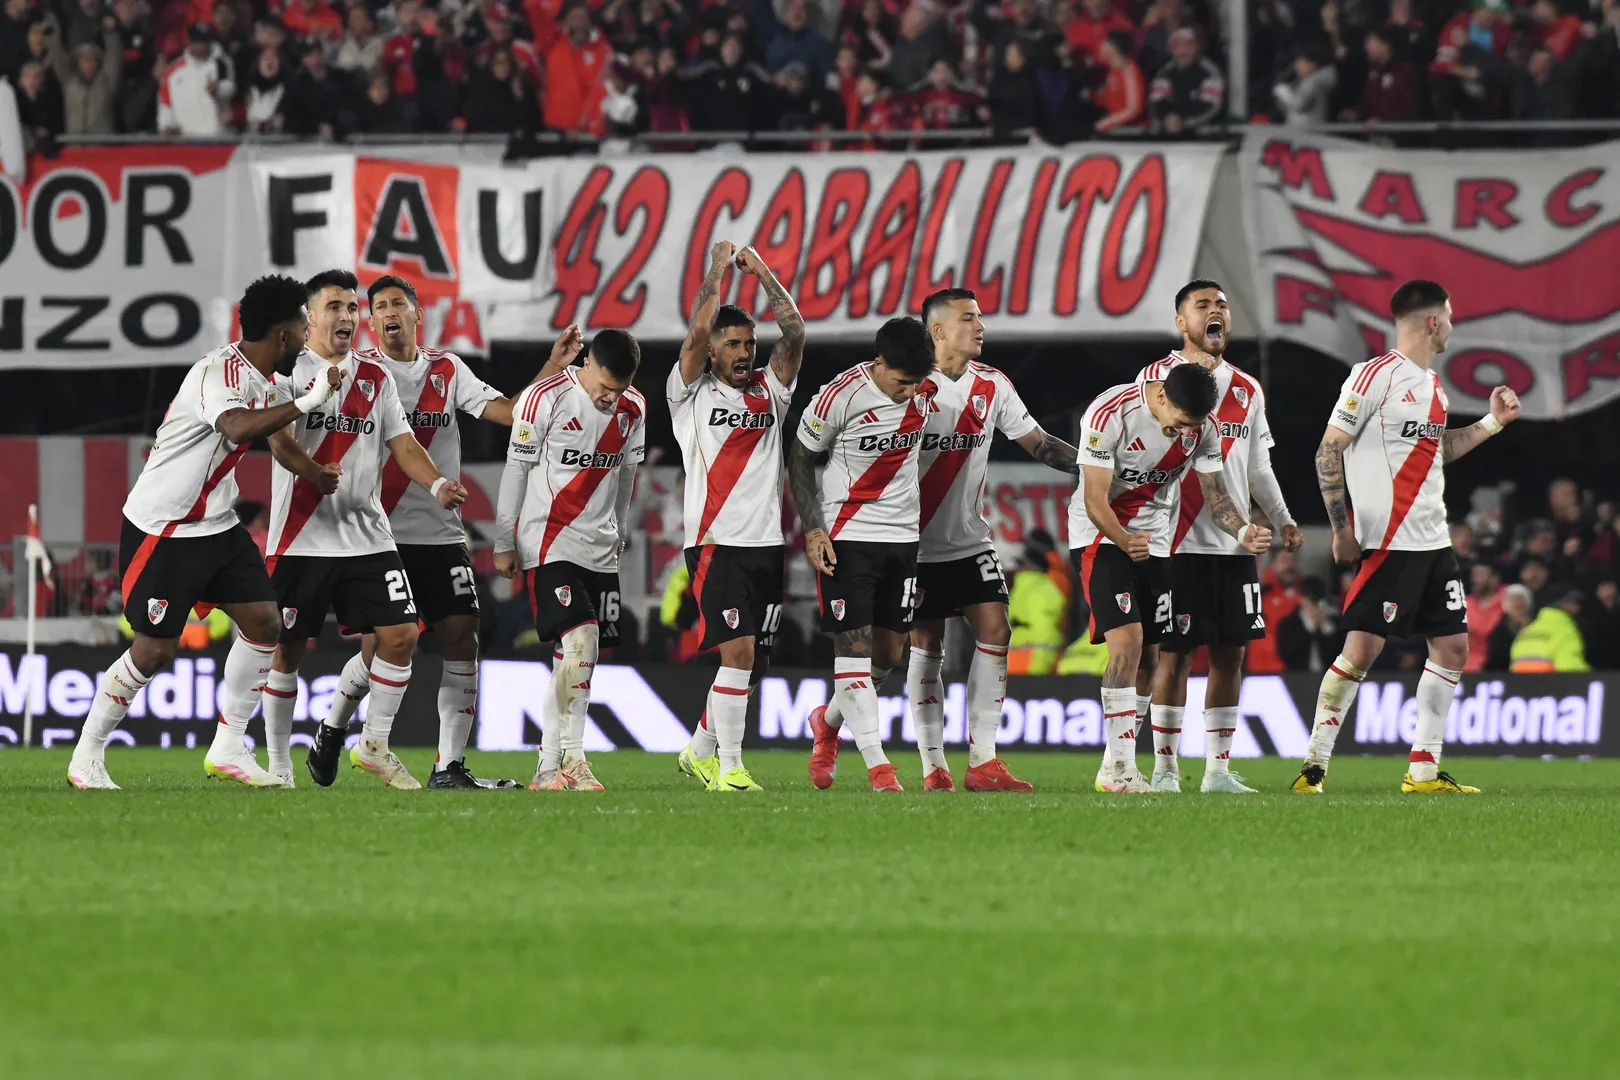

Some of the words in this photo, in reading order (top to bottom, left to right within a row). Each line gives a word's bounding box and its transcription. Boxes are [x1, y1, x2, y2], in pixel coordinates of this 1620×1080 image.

[1261, 139, 1605, 231] MARC
[550, 164, 670, 330] 42
[682, 152, 1167, 323] CABALLITO
[305, 411, 375, 435] Betano
[404, 409, 450, 428] tano
[1220, 422, 1249, 440] ano
[1400, 420, 1445, 439] Betan
[858, 429, 924, 452] Betan
[921, 433, 986, 451] Betano
[560, 448, 625, 468] Betano
[600, 591, 620, 622] 16
[1155, 590, 1172, 623] 2
[1243, 583, 1262, 615] 17
[761, 604, 782, 633] 10
[759, 677, 1109, 745] Mrdona
[1354, 680, 1604, 744] Meidional
